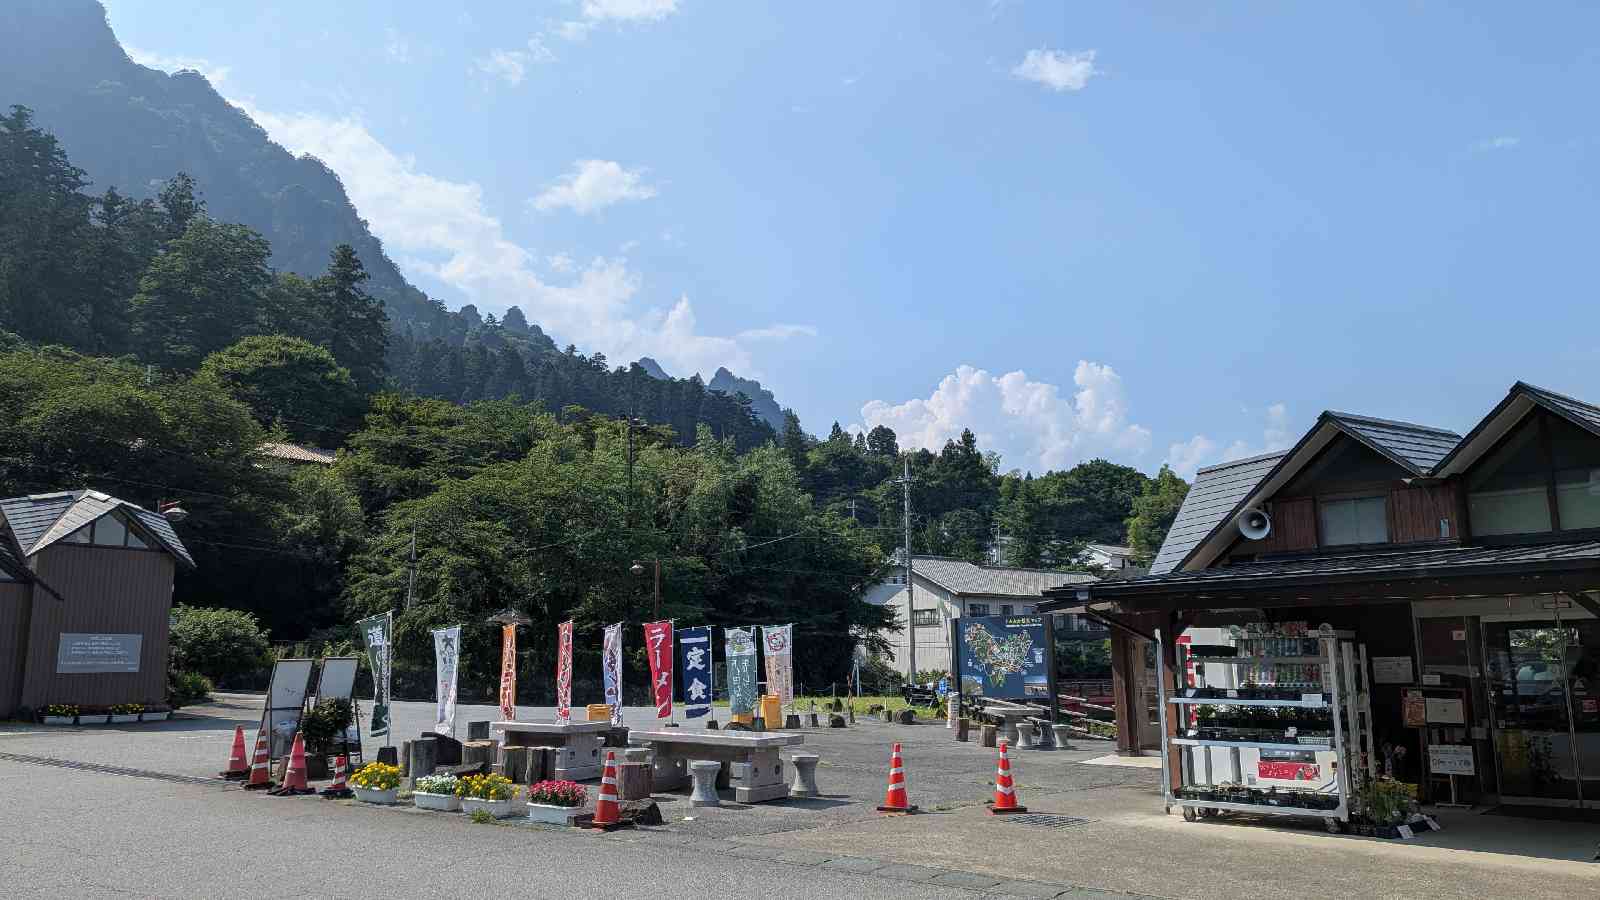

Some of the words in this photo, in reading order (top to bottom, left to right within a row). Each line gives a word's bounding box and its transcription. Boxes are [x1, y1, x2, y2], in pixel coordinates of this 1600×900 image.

[650, 628, 669, 718] ラーメン
[686, 647, 706, 700] 定食
